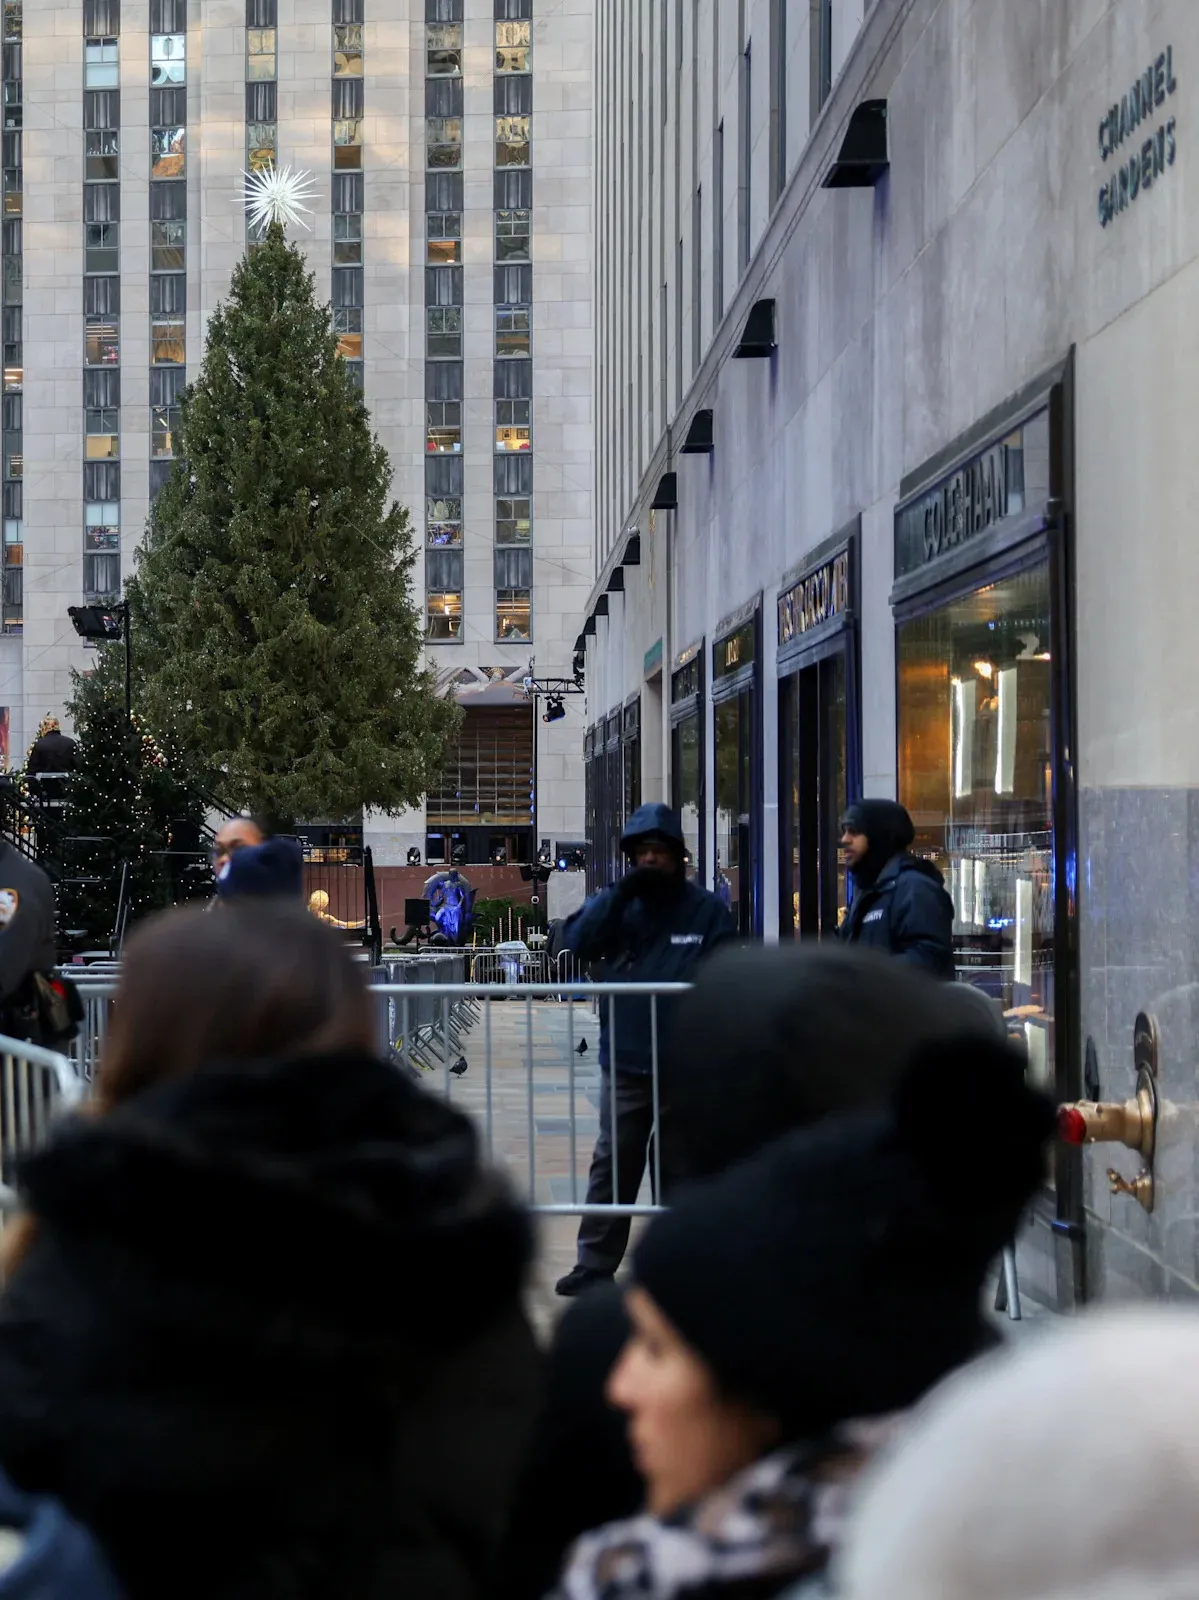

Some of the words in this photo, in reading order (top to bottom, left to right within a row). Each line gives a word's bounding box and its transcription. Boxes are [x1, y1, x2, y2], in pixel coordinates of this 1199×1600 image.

[1099, 44, 1178, 162] CHANNEL
[1098, 115, 1177, 229] GARDENS
[924, 477, 963, 561] COLE
[964, 443, 1009, 540] HAAN
